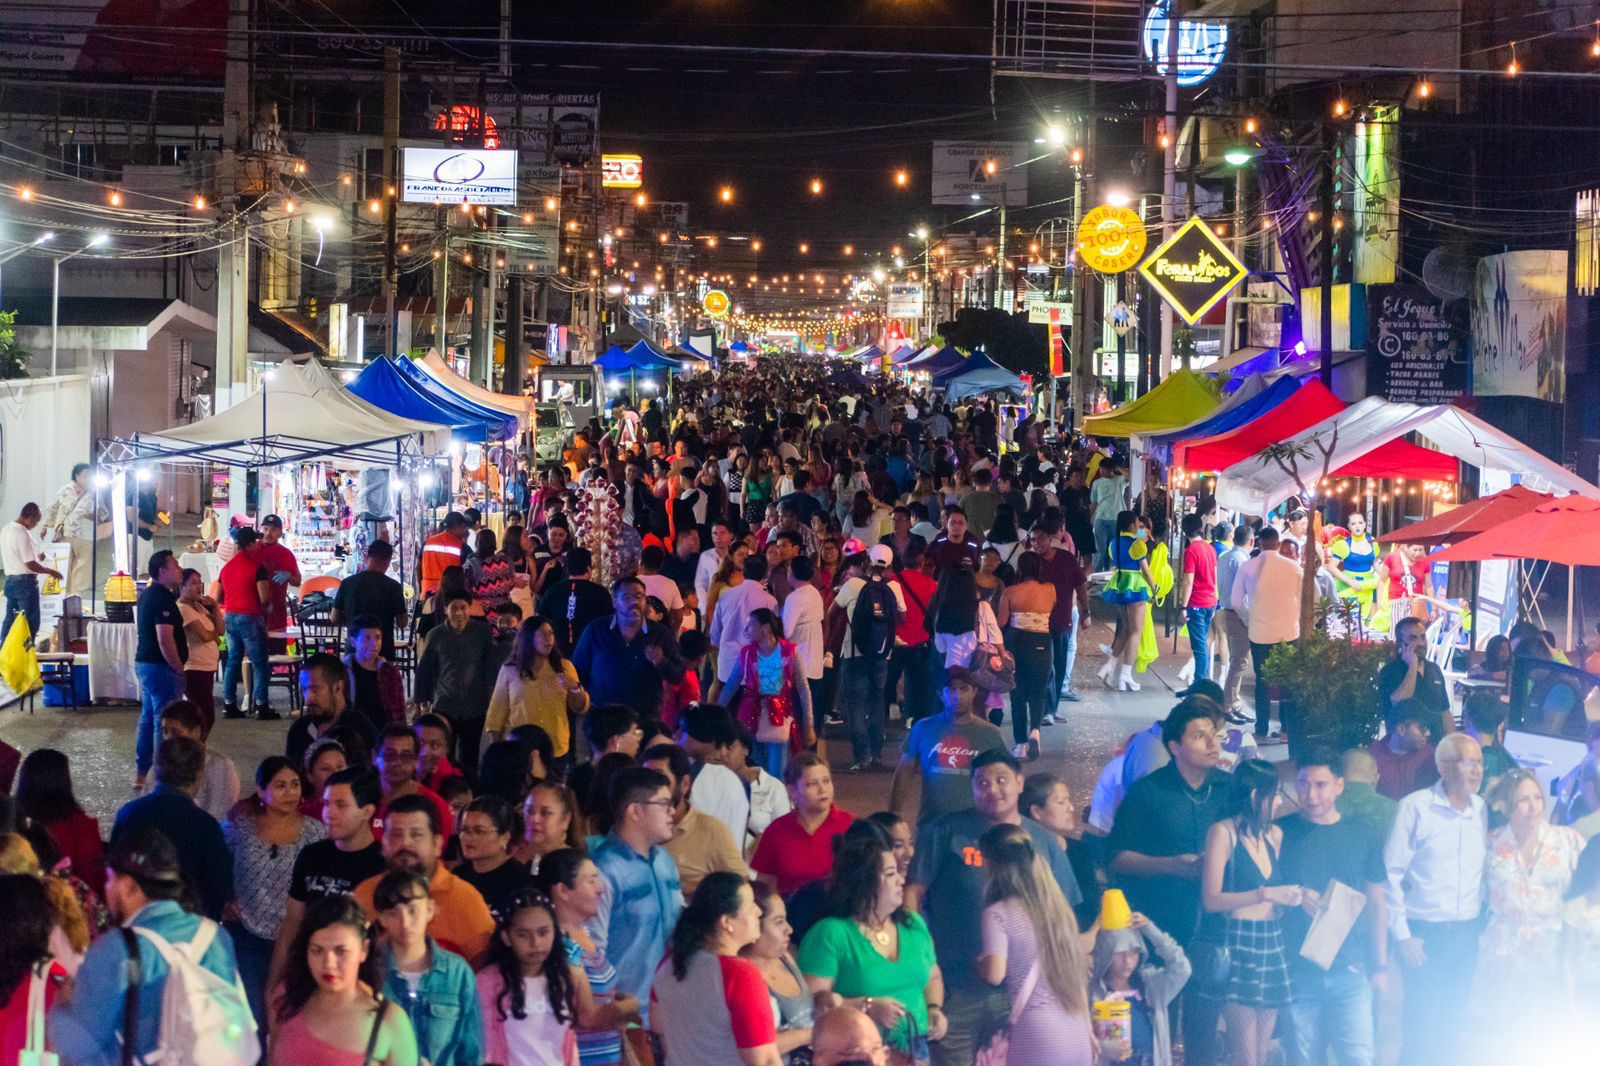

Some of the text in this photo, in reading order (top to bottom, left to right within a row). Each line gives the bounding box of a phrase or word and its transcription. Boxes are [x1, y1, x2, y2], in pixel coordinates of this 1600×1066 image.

[1087, 208, 1127, 227] SABOR
[1031, 305, 1067, 316] PHOIX
[1398, 299, 1436, 318] Jeque
[1378, 318, 1410, 329] Servicio
[1418, 320, 1452, 329] Domicilio
[1389, 388, 1417, 396] BEBIDAS
[928, 742, 980, 758] fusion
